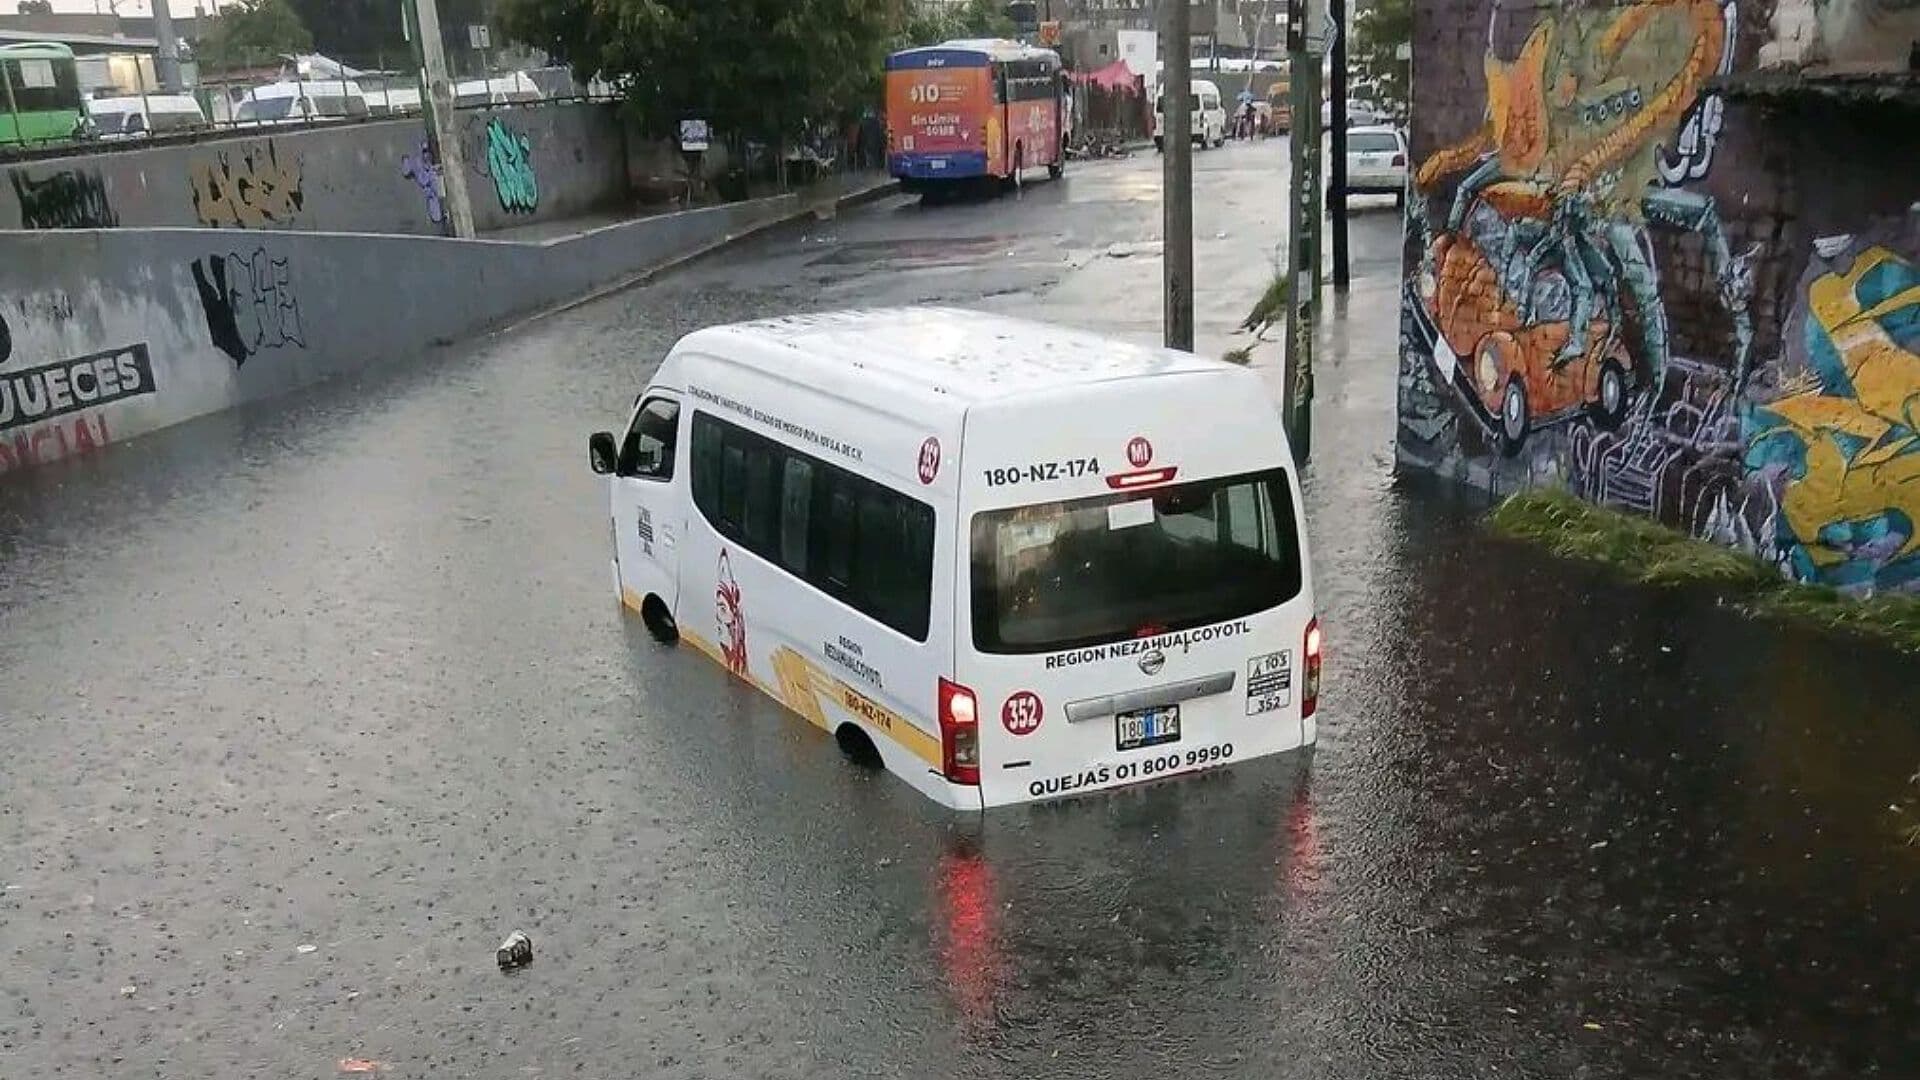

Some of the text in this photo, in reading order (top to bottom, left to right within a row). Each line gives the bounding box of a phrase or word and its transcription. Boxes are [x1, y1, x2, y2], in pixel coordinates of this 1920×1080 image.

[984, 457, 1100, 487] 180-NZ-174
[1046, 620, 1251, 669] REGION NEZAHUALCOYOTL
[1008, 696, 1038, 730] 352
[1258, 696, 1281, 712] 352
[1029, 743, 1234, 796] QUEJAS 01 800 9990
